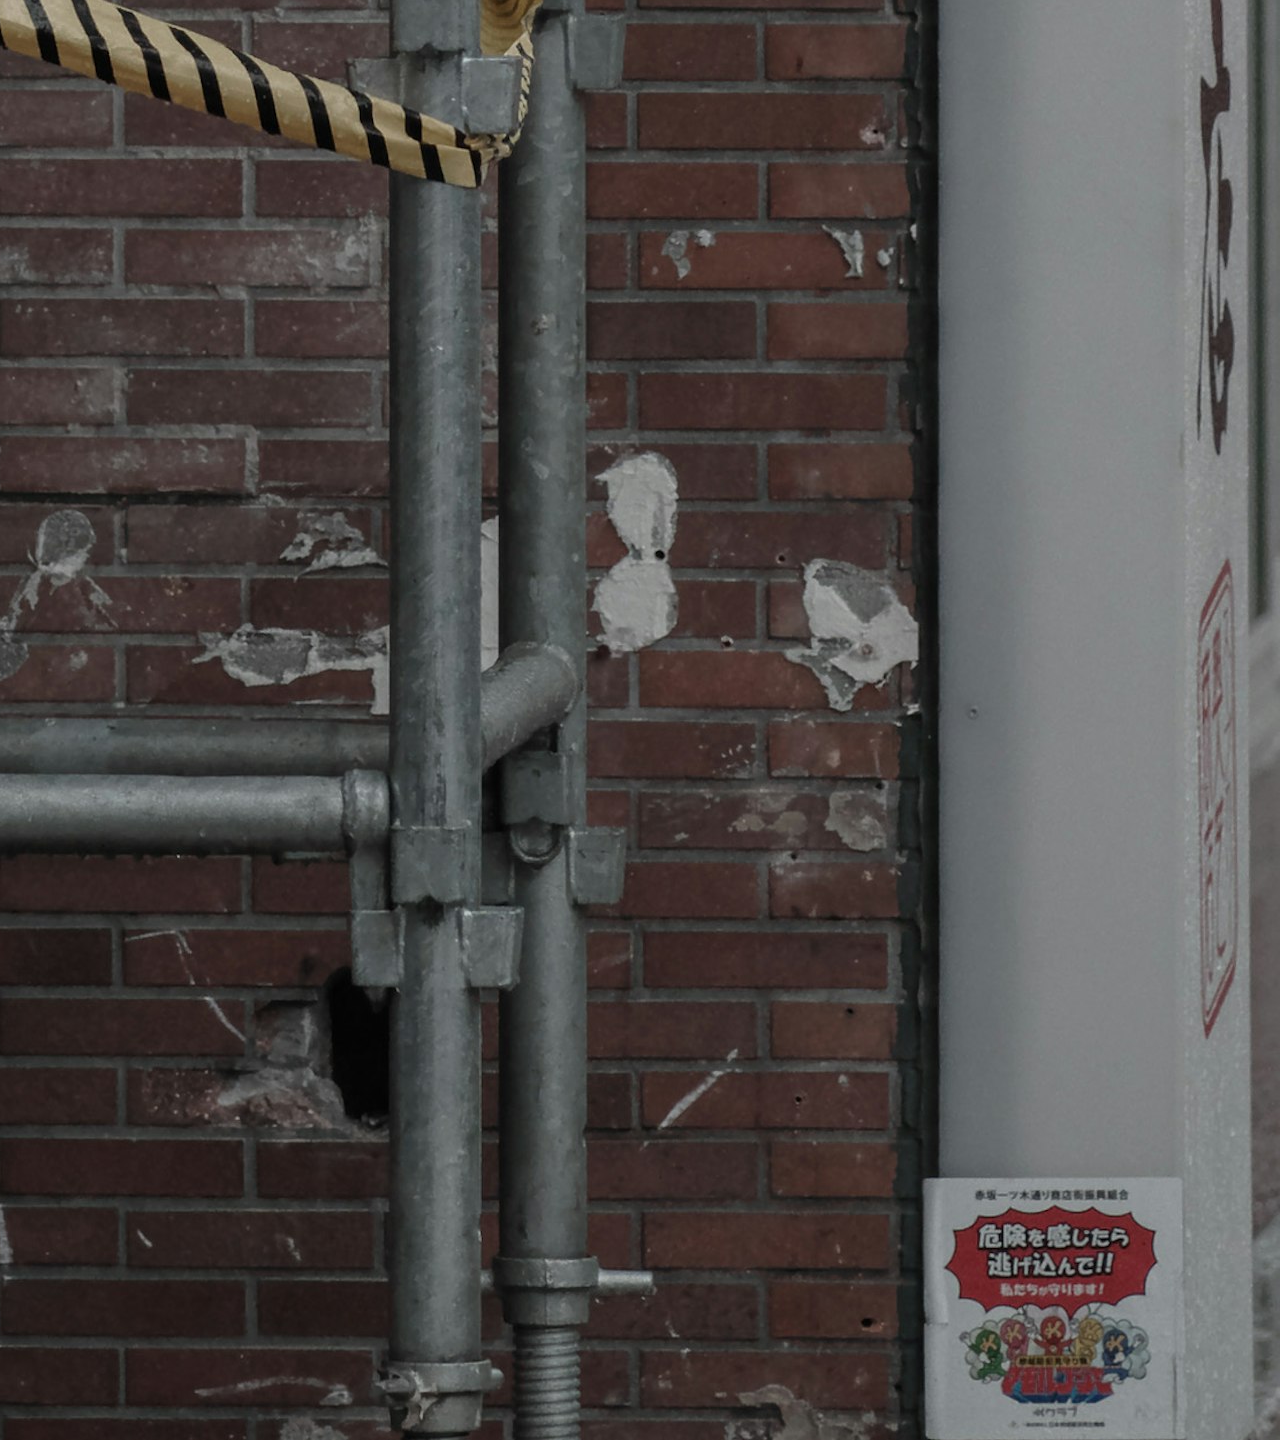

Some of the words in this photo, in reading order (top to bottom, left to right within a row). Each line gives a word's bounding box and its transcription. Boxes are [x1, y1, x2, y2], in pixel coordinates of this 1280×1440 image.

[977, 1223, 1131, 1250] 危険を感じたら
